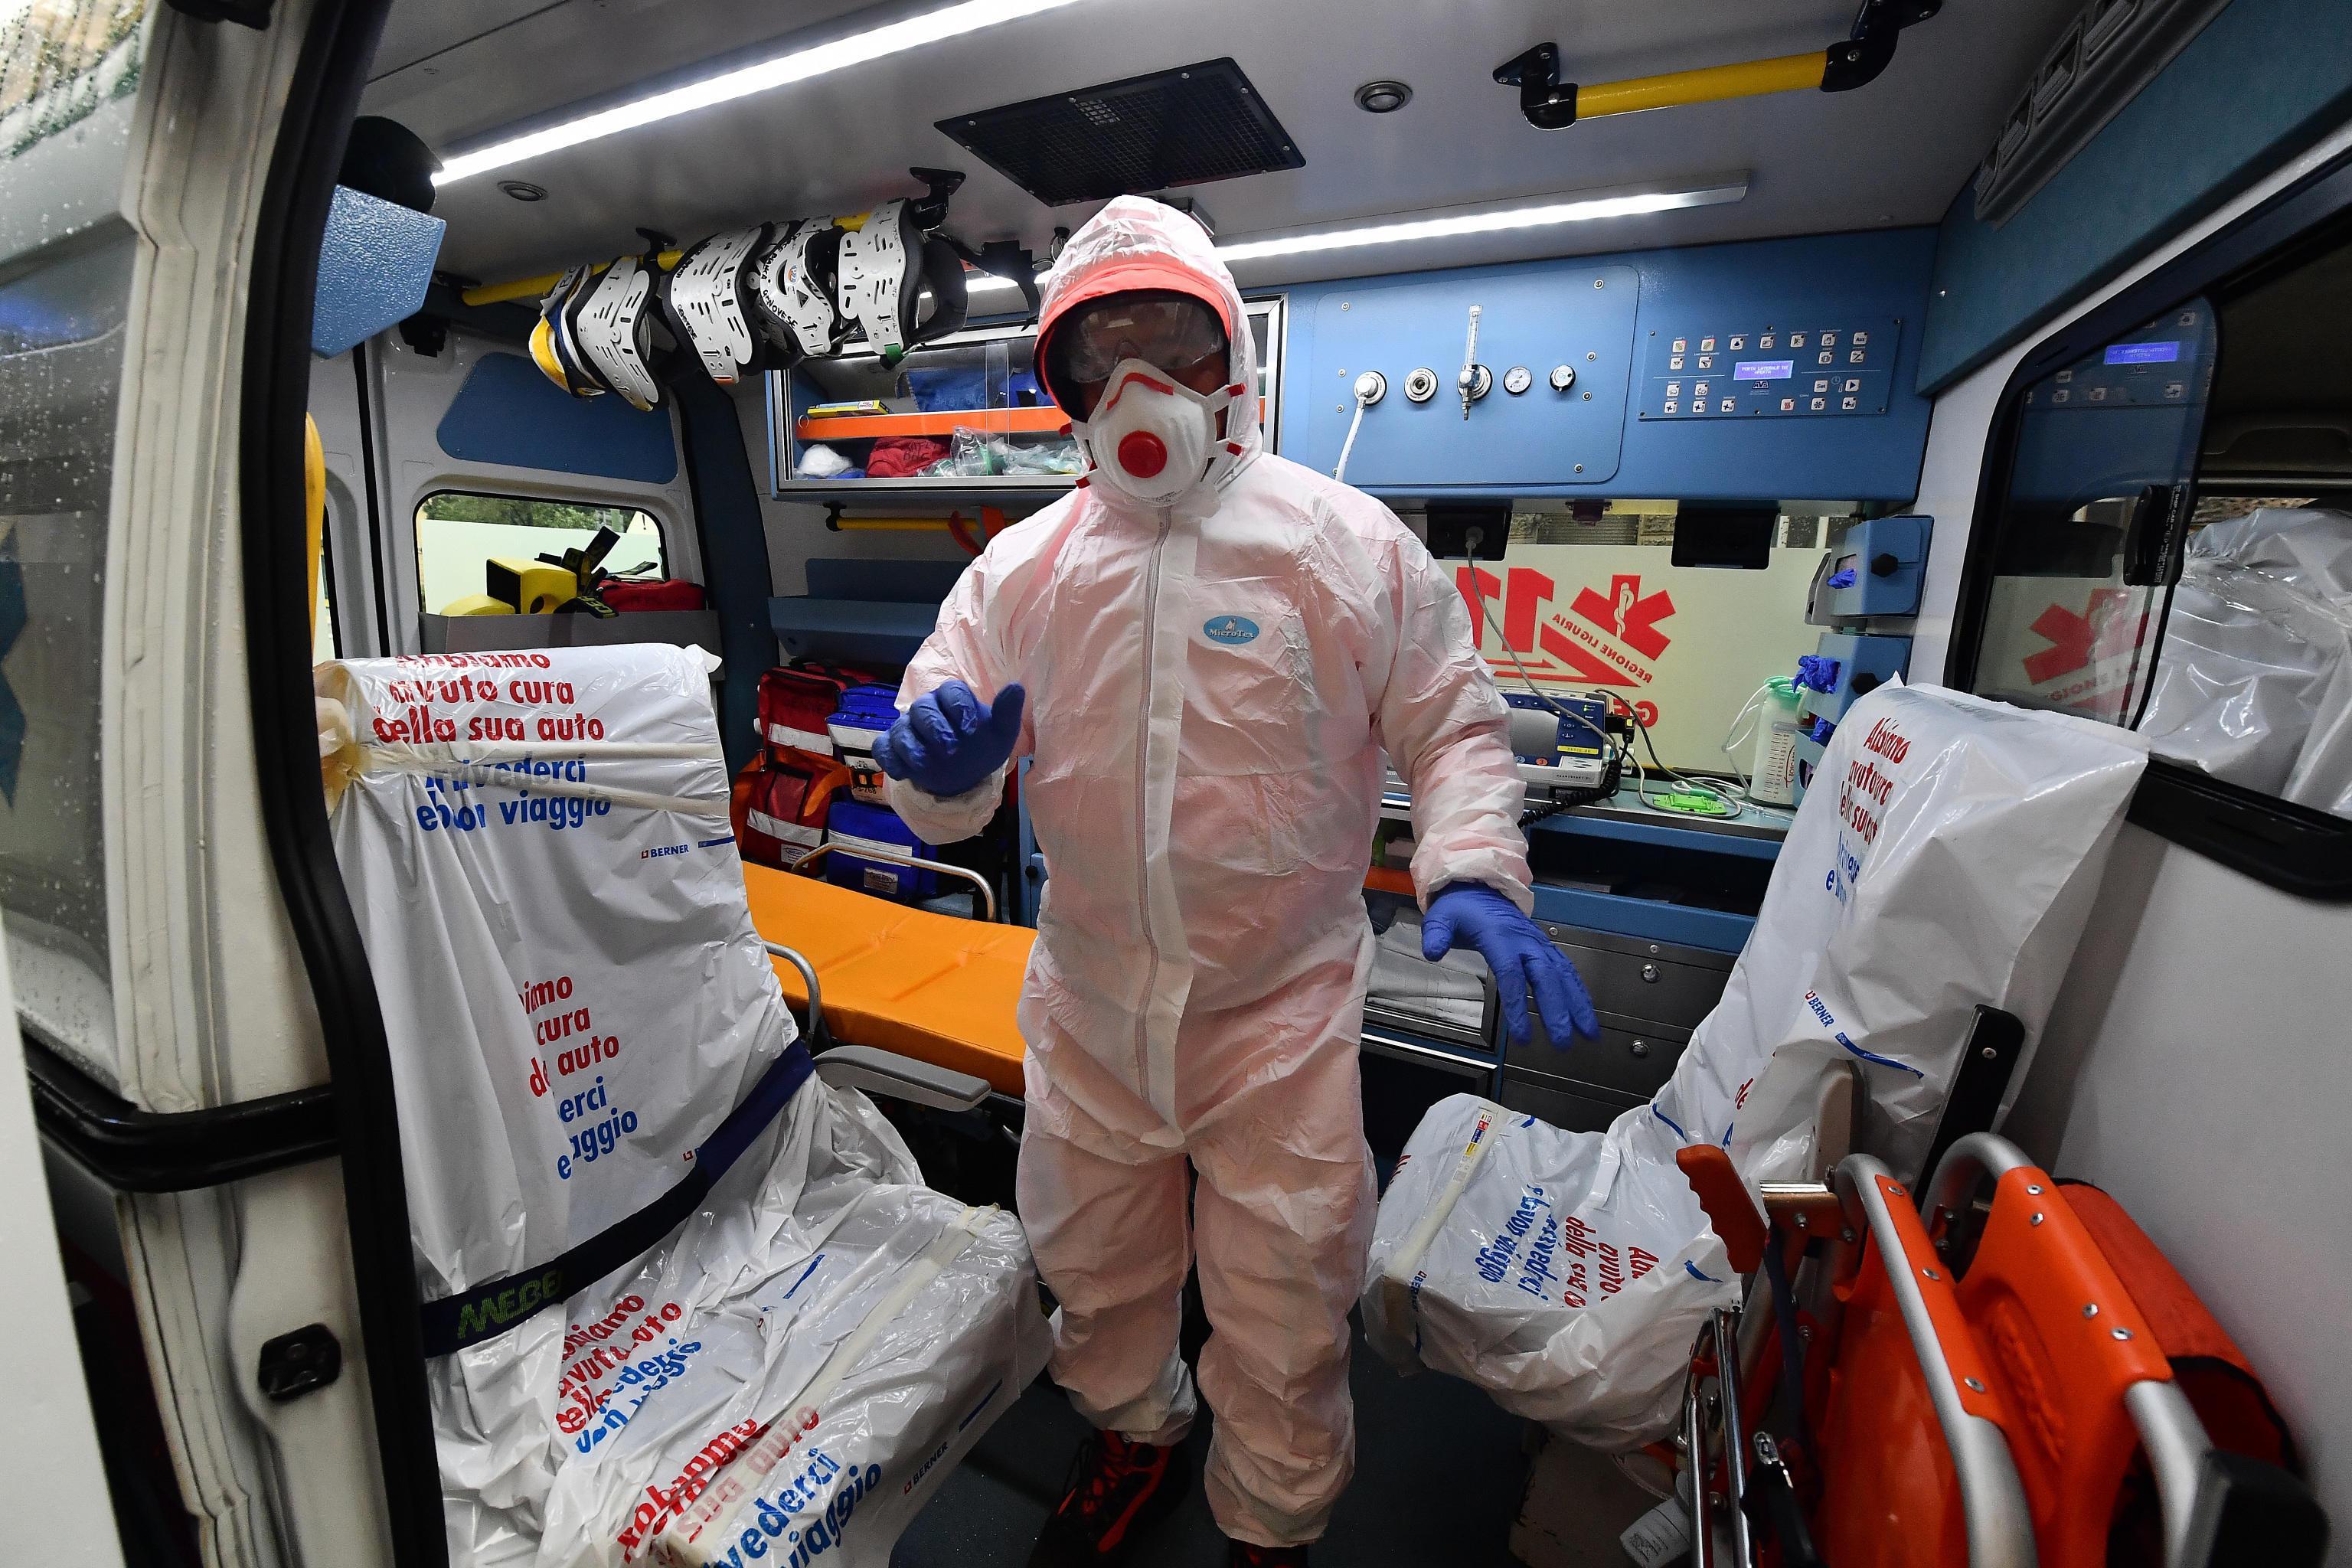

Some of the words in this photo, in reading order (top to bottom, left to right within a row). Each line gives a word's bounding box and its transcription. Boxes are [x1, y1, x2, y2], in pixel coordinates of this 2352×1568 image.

[388, 674, 499, 704] avuto
[508, 678, 576, 704] cura
[468, 715, 525, 742] sua
[537, 712, 605, 742] auto
[649, 843, 690, 858] BERNER
[1808, 995, 1835, 1030] BERNER
[557, 1035, 620, 1077] auto
[557, 1076, 608, 1125] erci
[1564, 1215, 1599, 1256] della
[1597, 1241, 1622, 1298] avuto
[912, 1440, 949, 1487] BERNER
